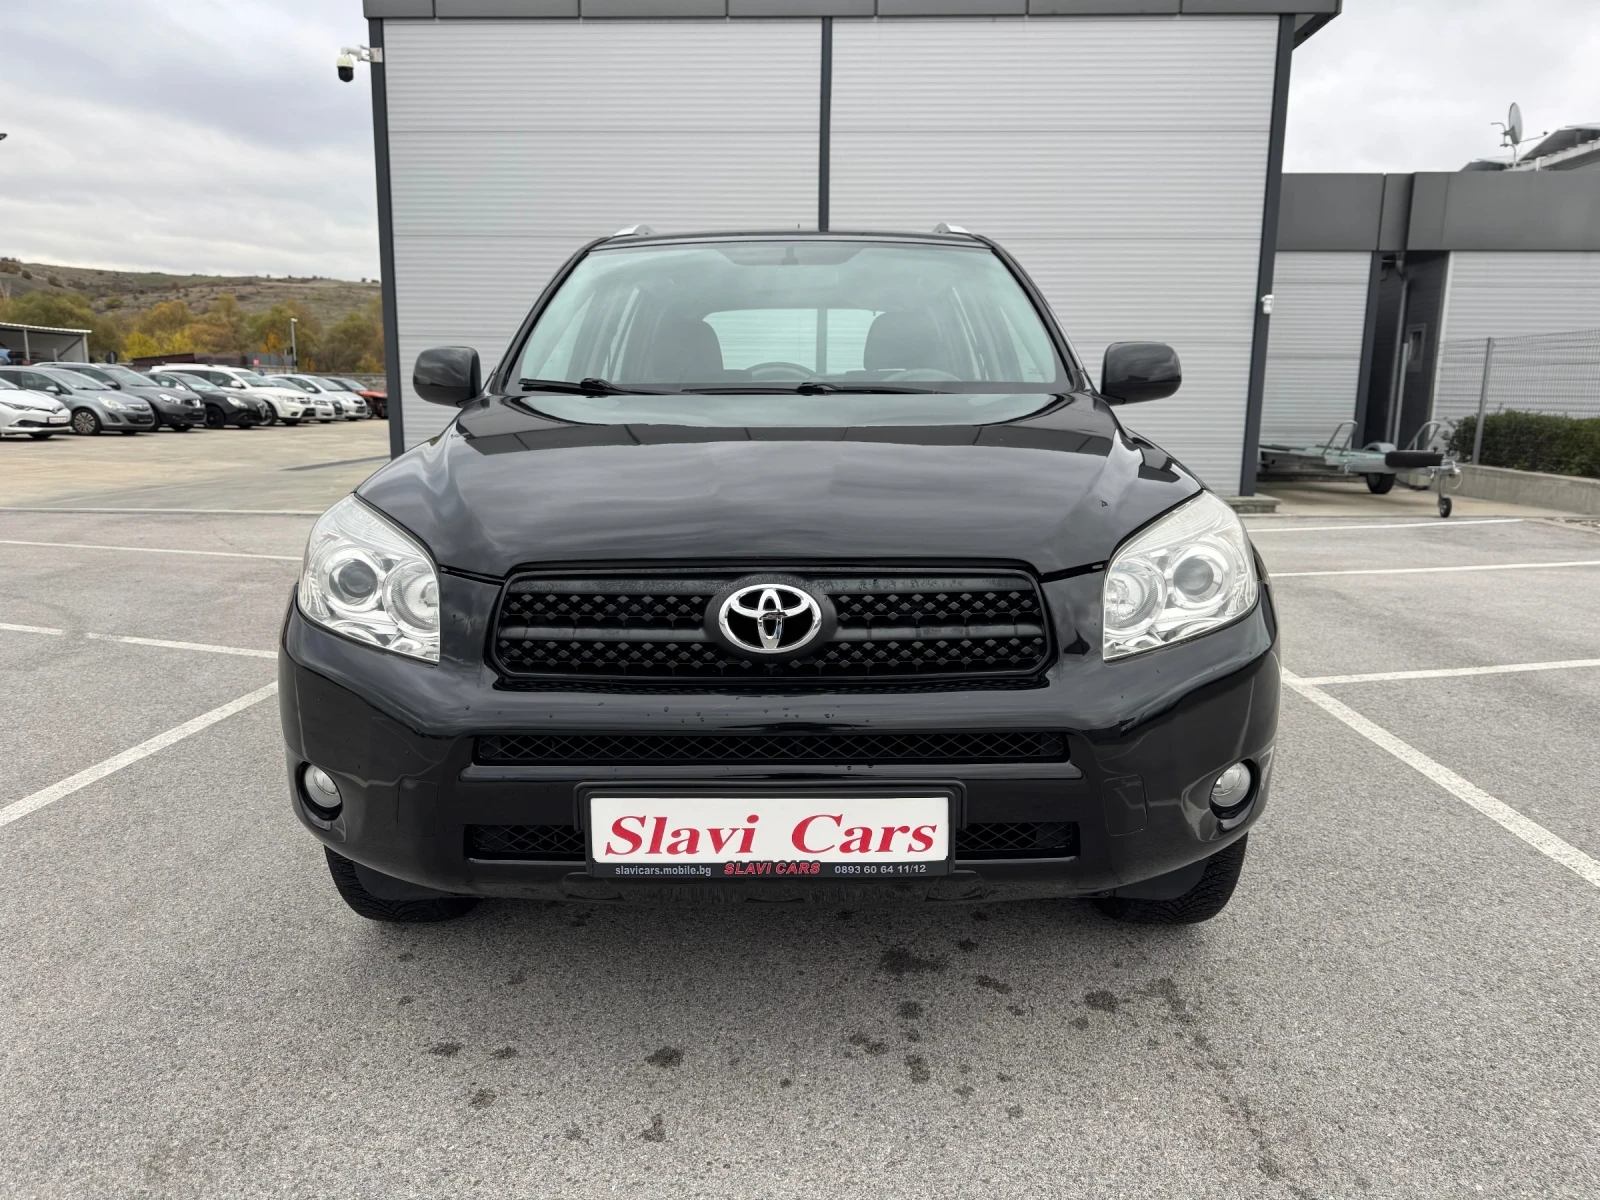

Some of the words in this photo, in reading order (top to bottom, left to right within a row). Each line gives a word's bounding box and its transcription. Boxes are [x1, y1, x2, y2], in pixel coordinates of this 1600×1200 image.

[605, 814, 759, 856] Slavi
[791, 814, 937, 855] Cars
[615, 865, 712, 877] slavicars.mobile.bg
[724, 862, 772, 875] SLAVI
[775, 862, 821, 875] CARS
[834, 865, 861, 874] 0893
[863, 865, 877, 874] 60
[880, 865, 894, 874] 64
[897, 864, 927, 874] 11/12
